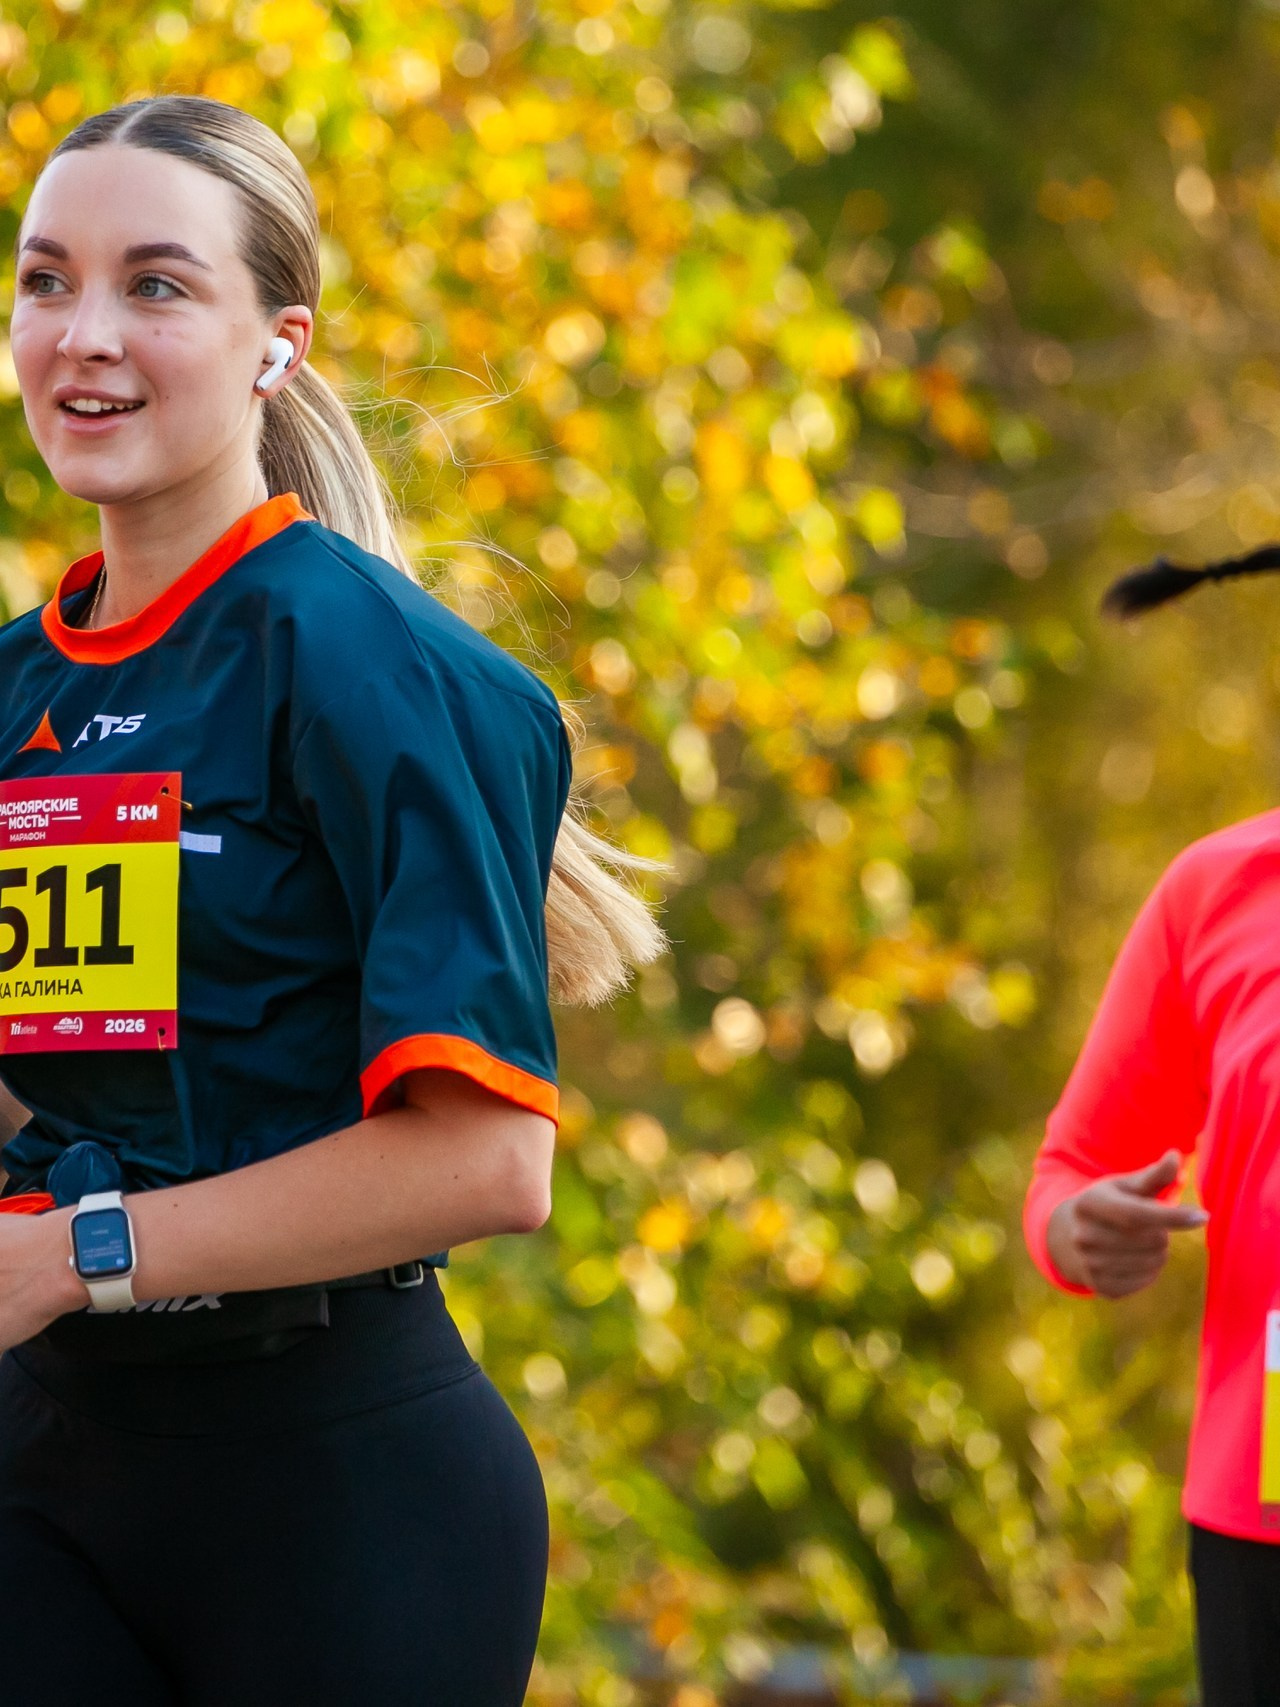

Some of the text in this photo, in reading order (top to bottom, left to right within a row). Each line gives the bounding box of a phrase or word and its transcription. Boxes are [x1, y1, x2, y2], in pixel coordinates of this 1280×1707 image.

[116, 805, 127, 821] 5
[8, 814, 50, 830] МОСТЫ
[9, 831, 47, 842] МАРАФОН
[14, 979, 84, 998] ГАЛИНА
[104, 1018, 146, 1034] 2026
